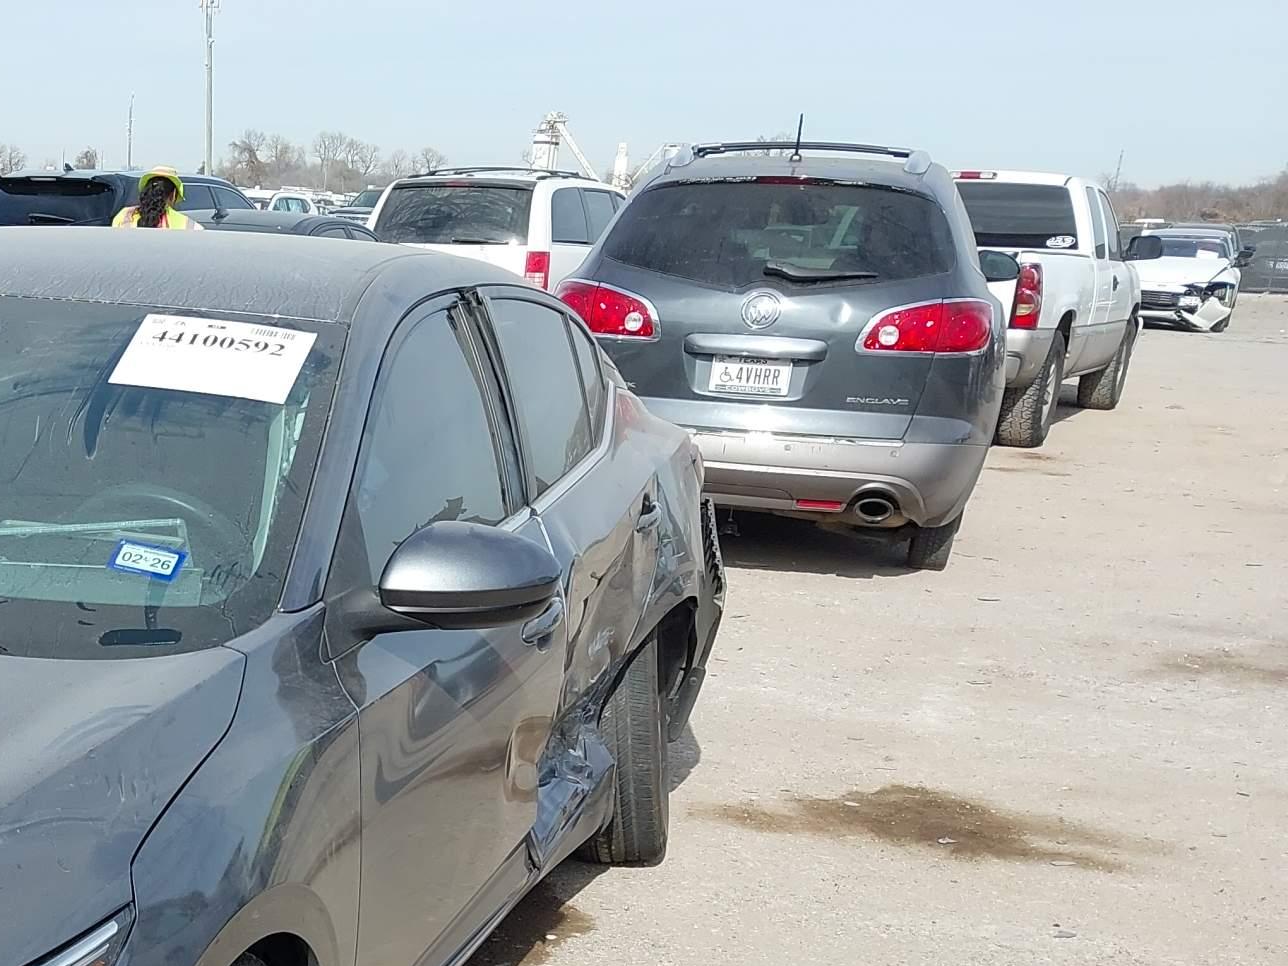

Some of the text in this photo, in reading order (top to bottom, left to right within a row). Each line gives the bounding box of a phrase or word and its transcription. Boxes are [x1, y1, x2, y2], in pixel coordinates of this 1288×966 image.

[152, 330, 286, 356] 44100592
[736, 366, 781, 386] 4VHRR
[846, 396, 909, 406] ENCLAVE
